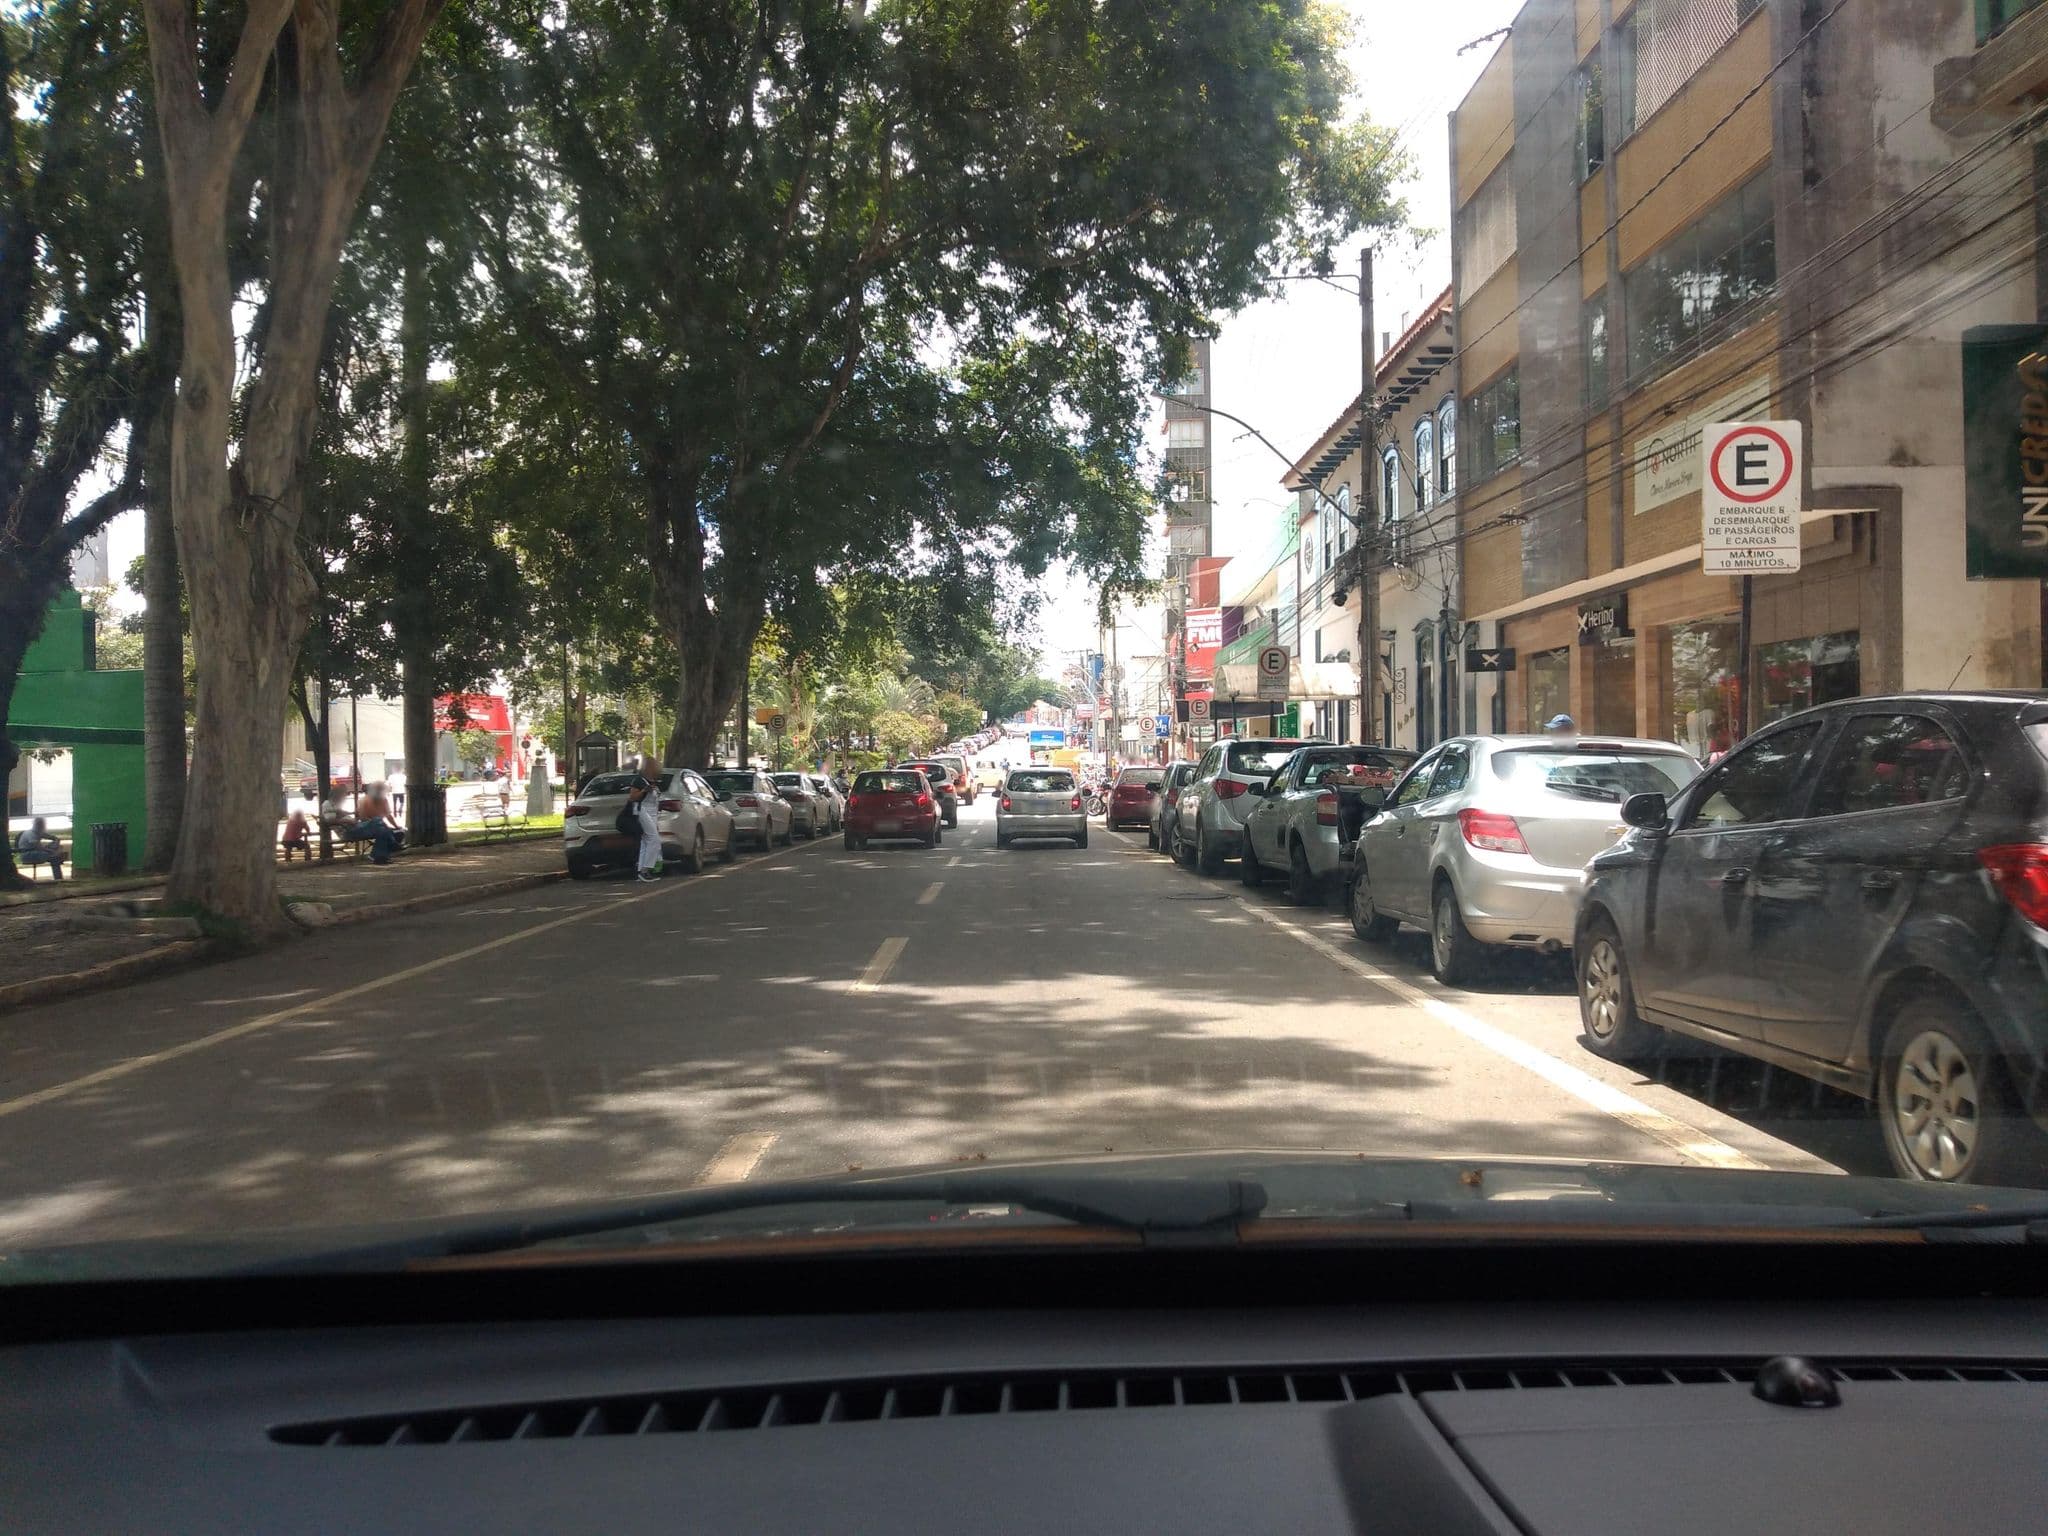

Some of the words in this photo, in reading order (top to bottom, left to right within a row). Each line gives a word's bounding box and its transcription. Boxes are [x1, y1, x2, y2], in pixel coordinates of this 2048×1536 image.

[1736, 444, 1769, 486] E
[1719, 506, 1776, 515] EMBARQUE
[1713, 515, 1790, 525] DESEMBARQUE
[1708, 527, 1722, 535] DE
[1734, 535, 1777, 545] CARGAS
[1720, 560, 1731, 568] 10
[1734, 557, 1785, 568] MINUTOS
[1588, 607, 1614, 628] Hering
[1268, 653, 1279, 670] E
[1196, 702, 1202, 712] E
[1144, 720, 1150, 729] E
